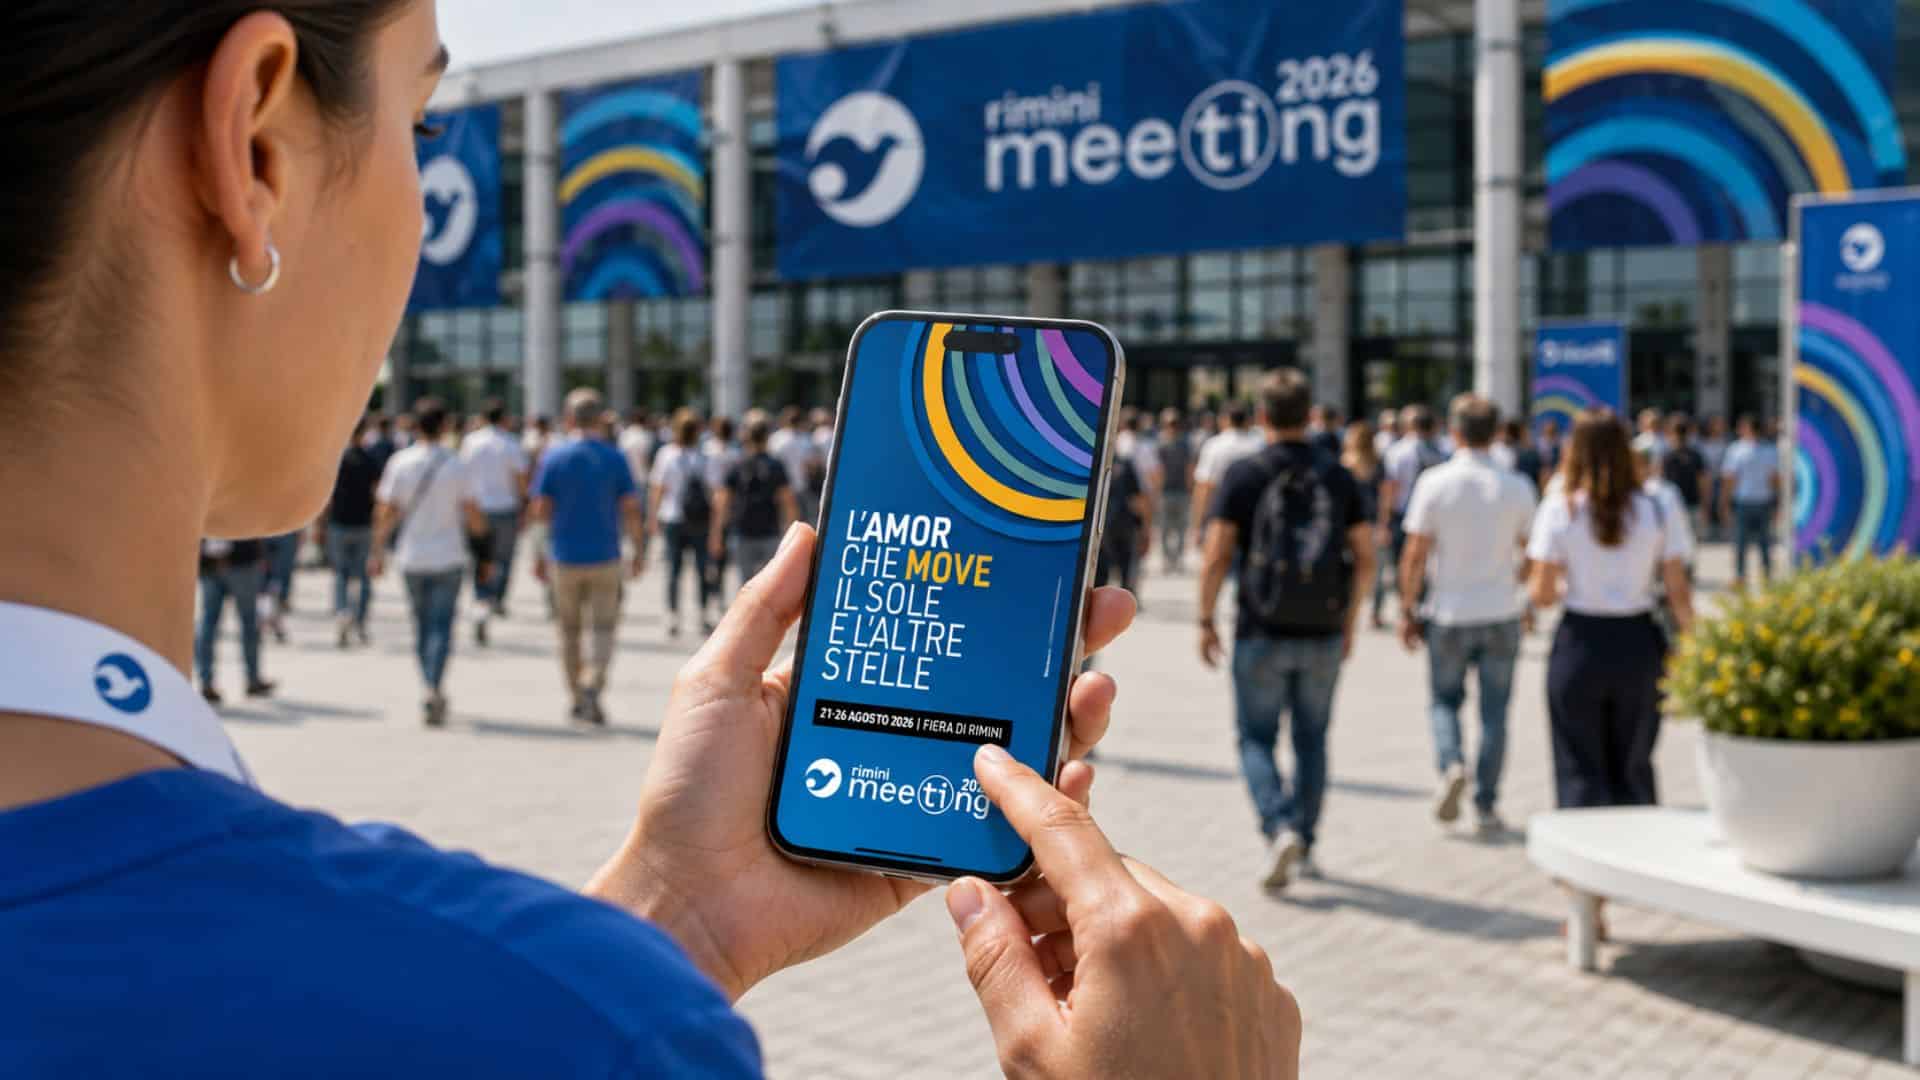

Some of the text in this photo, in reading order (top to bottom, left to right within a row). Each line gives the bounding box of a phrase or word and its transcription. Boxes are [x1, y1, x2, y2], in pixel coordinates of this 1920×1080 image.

[1276, 51, 1379, 101] 2026
[985, 83, 1100, 128] rimini
[985, 96, 1381, 191] meeting
[846, 509, 952, 548] L'AMOR
[840, 543, 993, 587] CHE MOVE
[834, 577, 943, 618] IL SOLE
[828, 612, 966, 657] E L'ALTRE
[821, 647, 934, 690] STELLE
[848, 711, 889, 726] AGOSTO
[890, 715, 914, 728] 2026
[922, 719, 952, 733] FIERA
[955, 724, 967, 735] DI
[968, 725, 1003, 740] RIMINI
[851, 765, 890, 781] rimini
[848, 778, 990, 820] meeting
